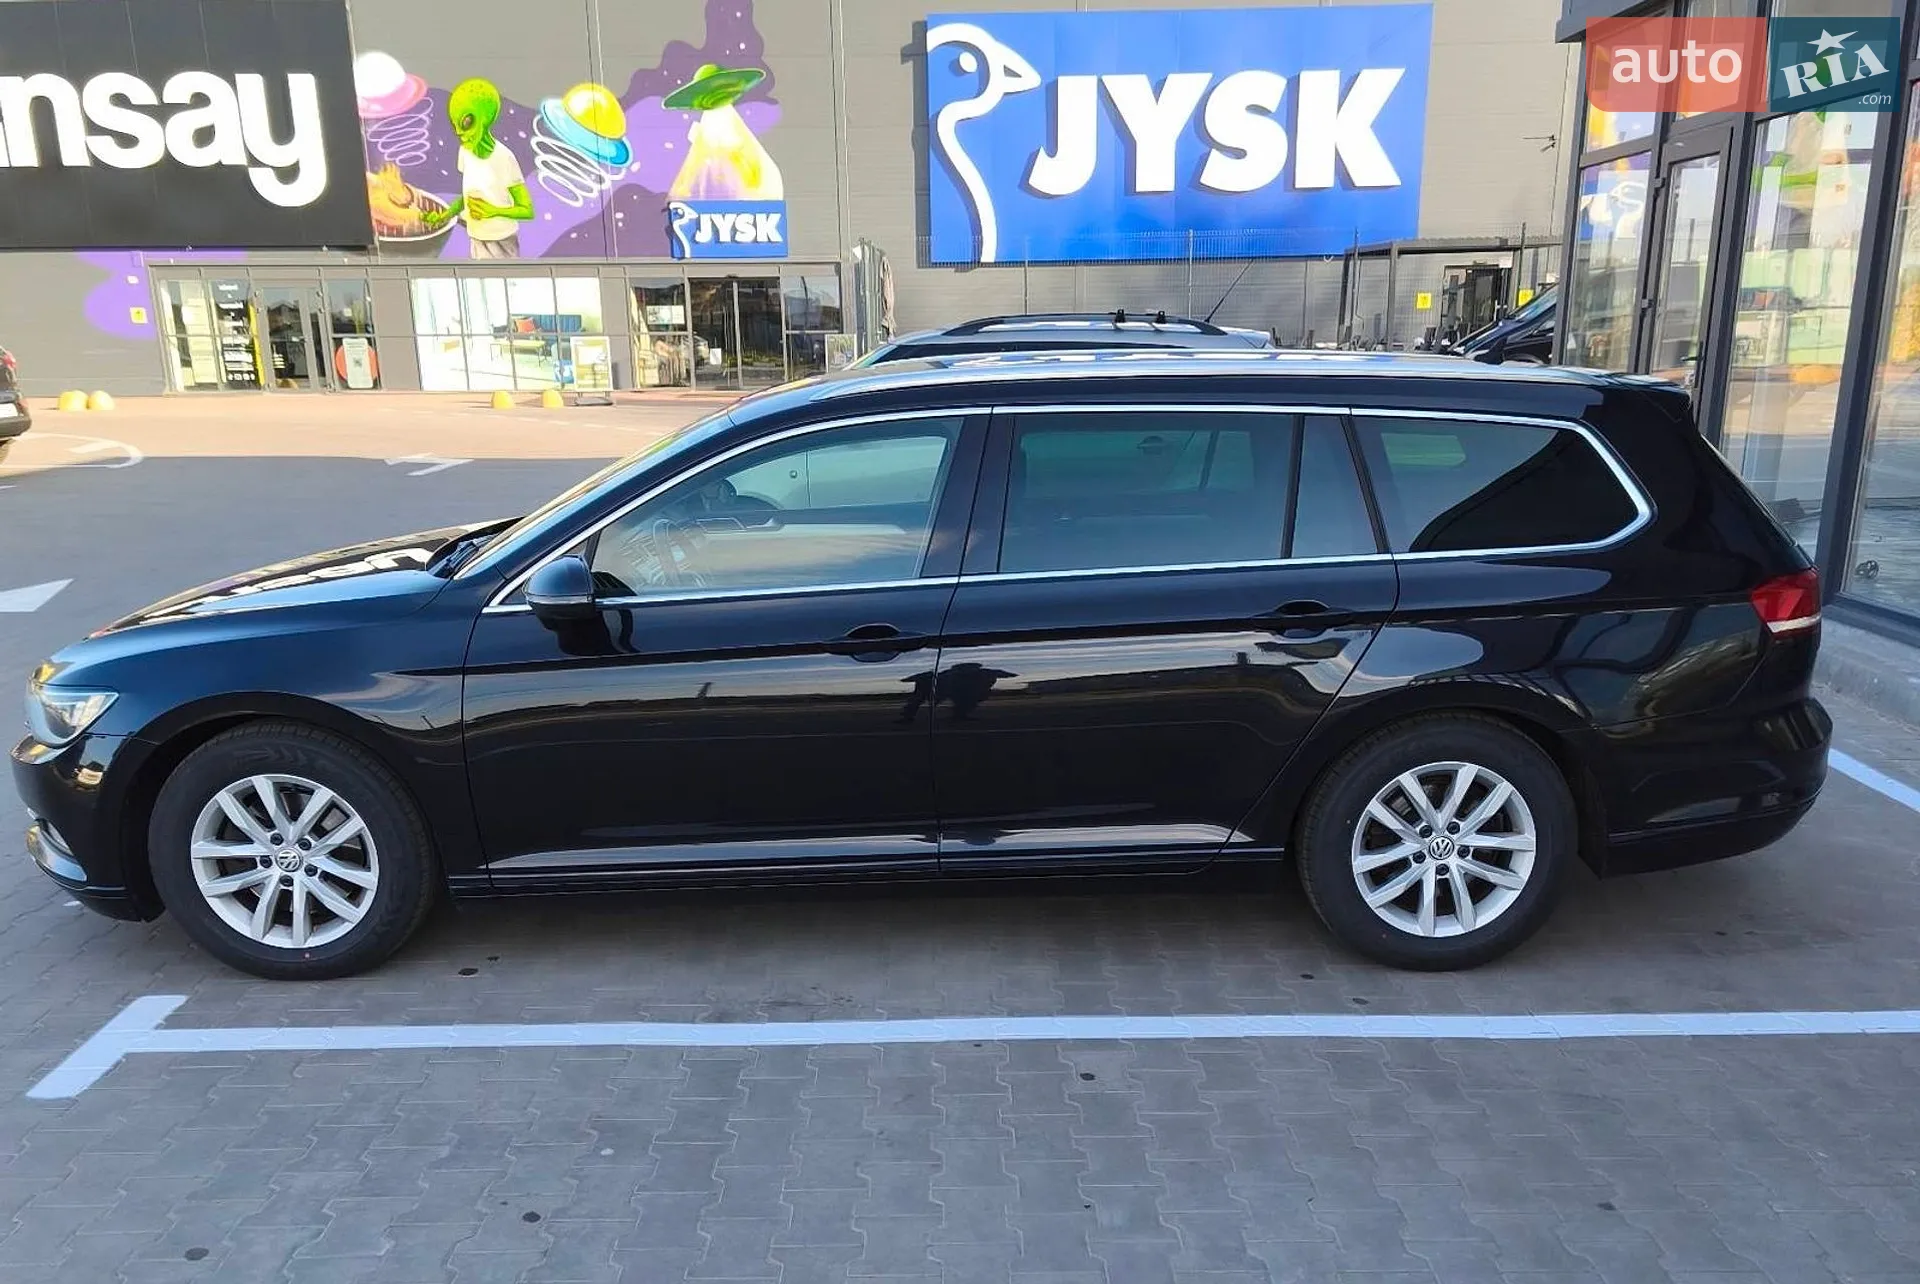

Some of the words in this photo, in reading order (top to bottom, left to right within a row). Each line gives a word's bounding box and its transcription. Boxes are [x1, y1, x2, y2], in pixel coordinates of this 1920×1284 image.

[0, 71, 327, 207] nsay
[1027, 67, 1406, 196] JYSK
[694, 212, 784, 243] JYSK
